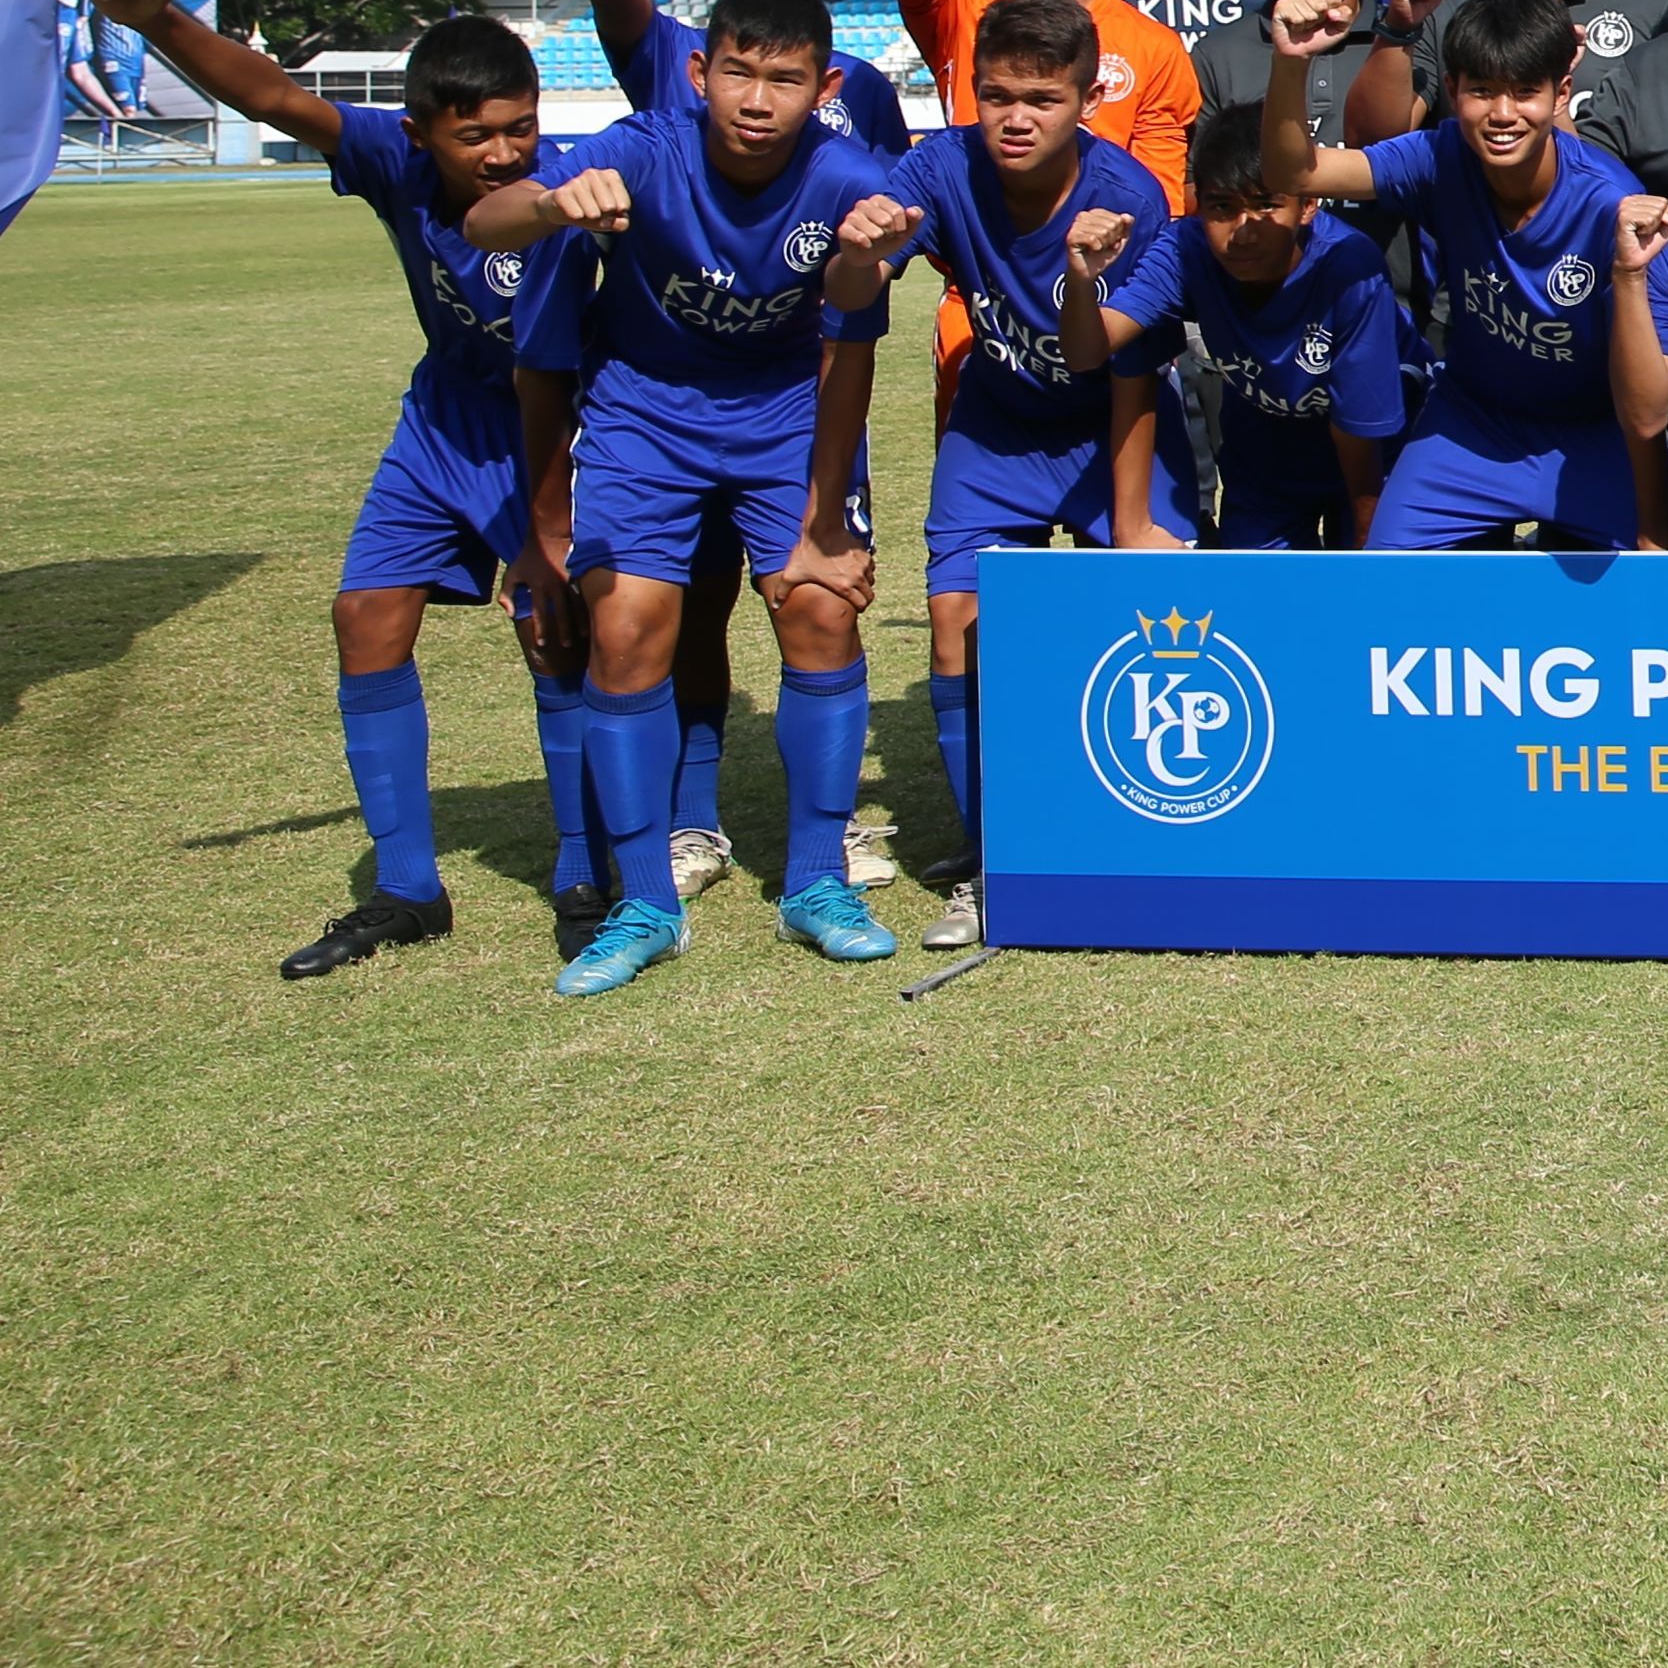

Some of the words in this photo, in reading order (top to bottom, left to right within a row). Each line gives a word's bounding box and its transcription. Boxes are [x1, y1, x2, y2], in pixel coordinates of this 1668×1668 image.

[668, 272, 805, 319] KING
[1464, 268, 1573, 344] KING
[1464, 296, 1575, 363] POWER
[1370, 647, 1600, 719] KING
[1516, 745, 1628, 792] THE
[1127, 786, 1158, 810] KING
[1160, 801, 1206, 815] POWER
[1206, 789, 1232, 809] CUP
